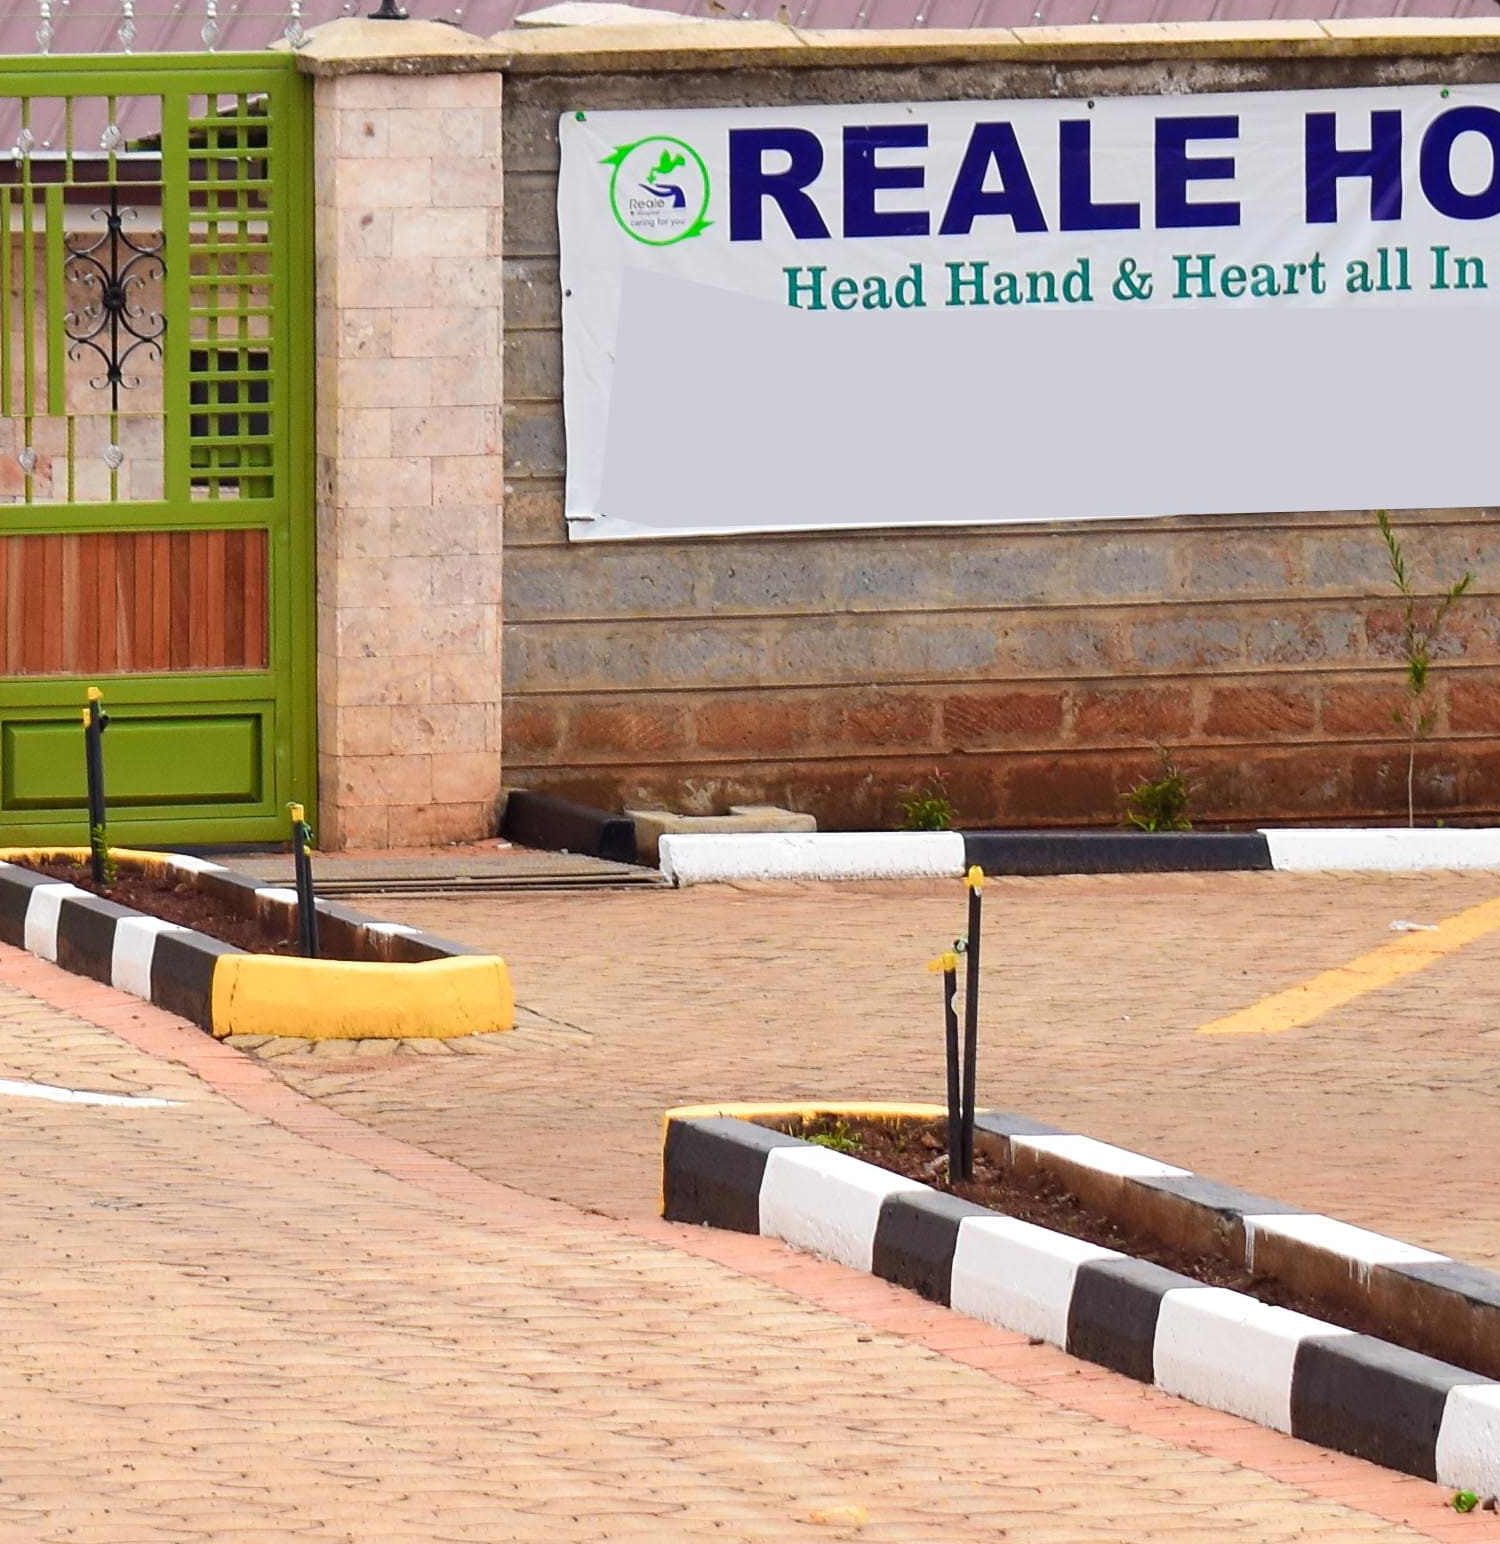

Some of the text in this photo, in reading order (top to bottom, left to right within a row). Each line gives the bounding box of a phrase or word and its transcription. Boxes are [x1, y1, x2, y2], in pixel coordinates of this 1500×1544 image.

[629, 198, 665, 209] Reale
[729, 117, 1241, 242] REALE
[783, 262, 926, 311] Head
[945, 257, 1093, 306] Hand
[1112, 257, 1154, 302] &
[1172, 252, 1327, 299] Heart
[1346, 246, 1412, 294] all
[1430, 245, 1488, 290] In
